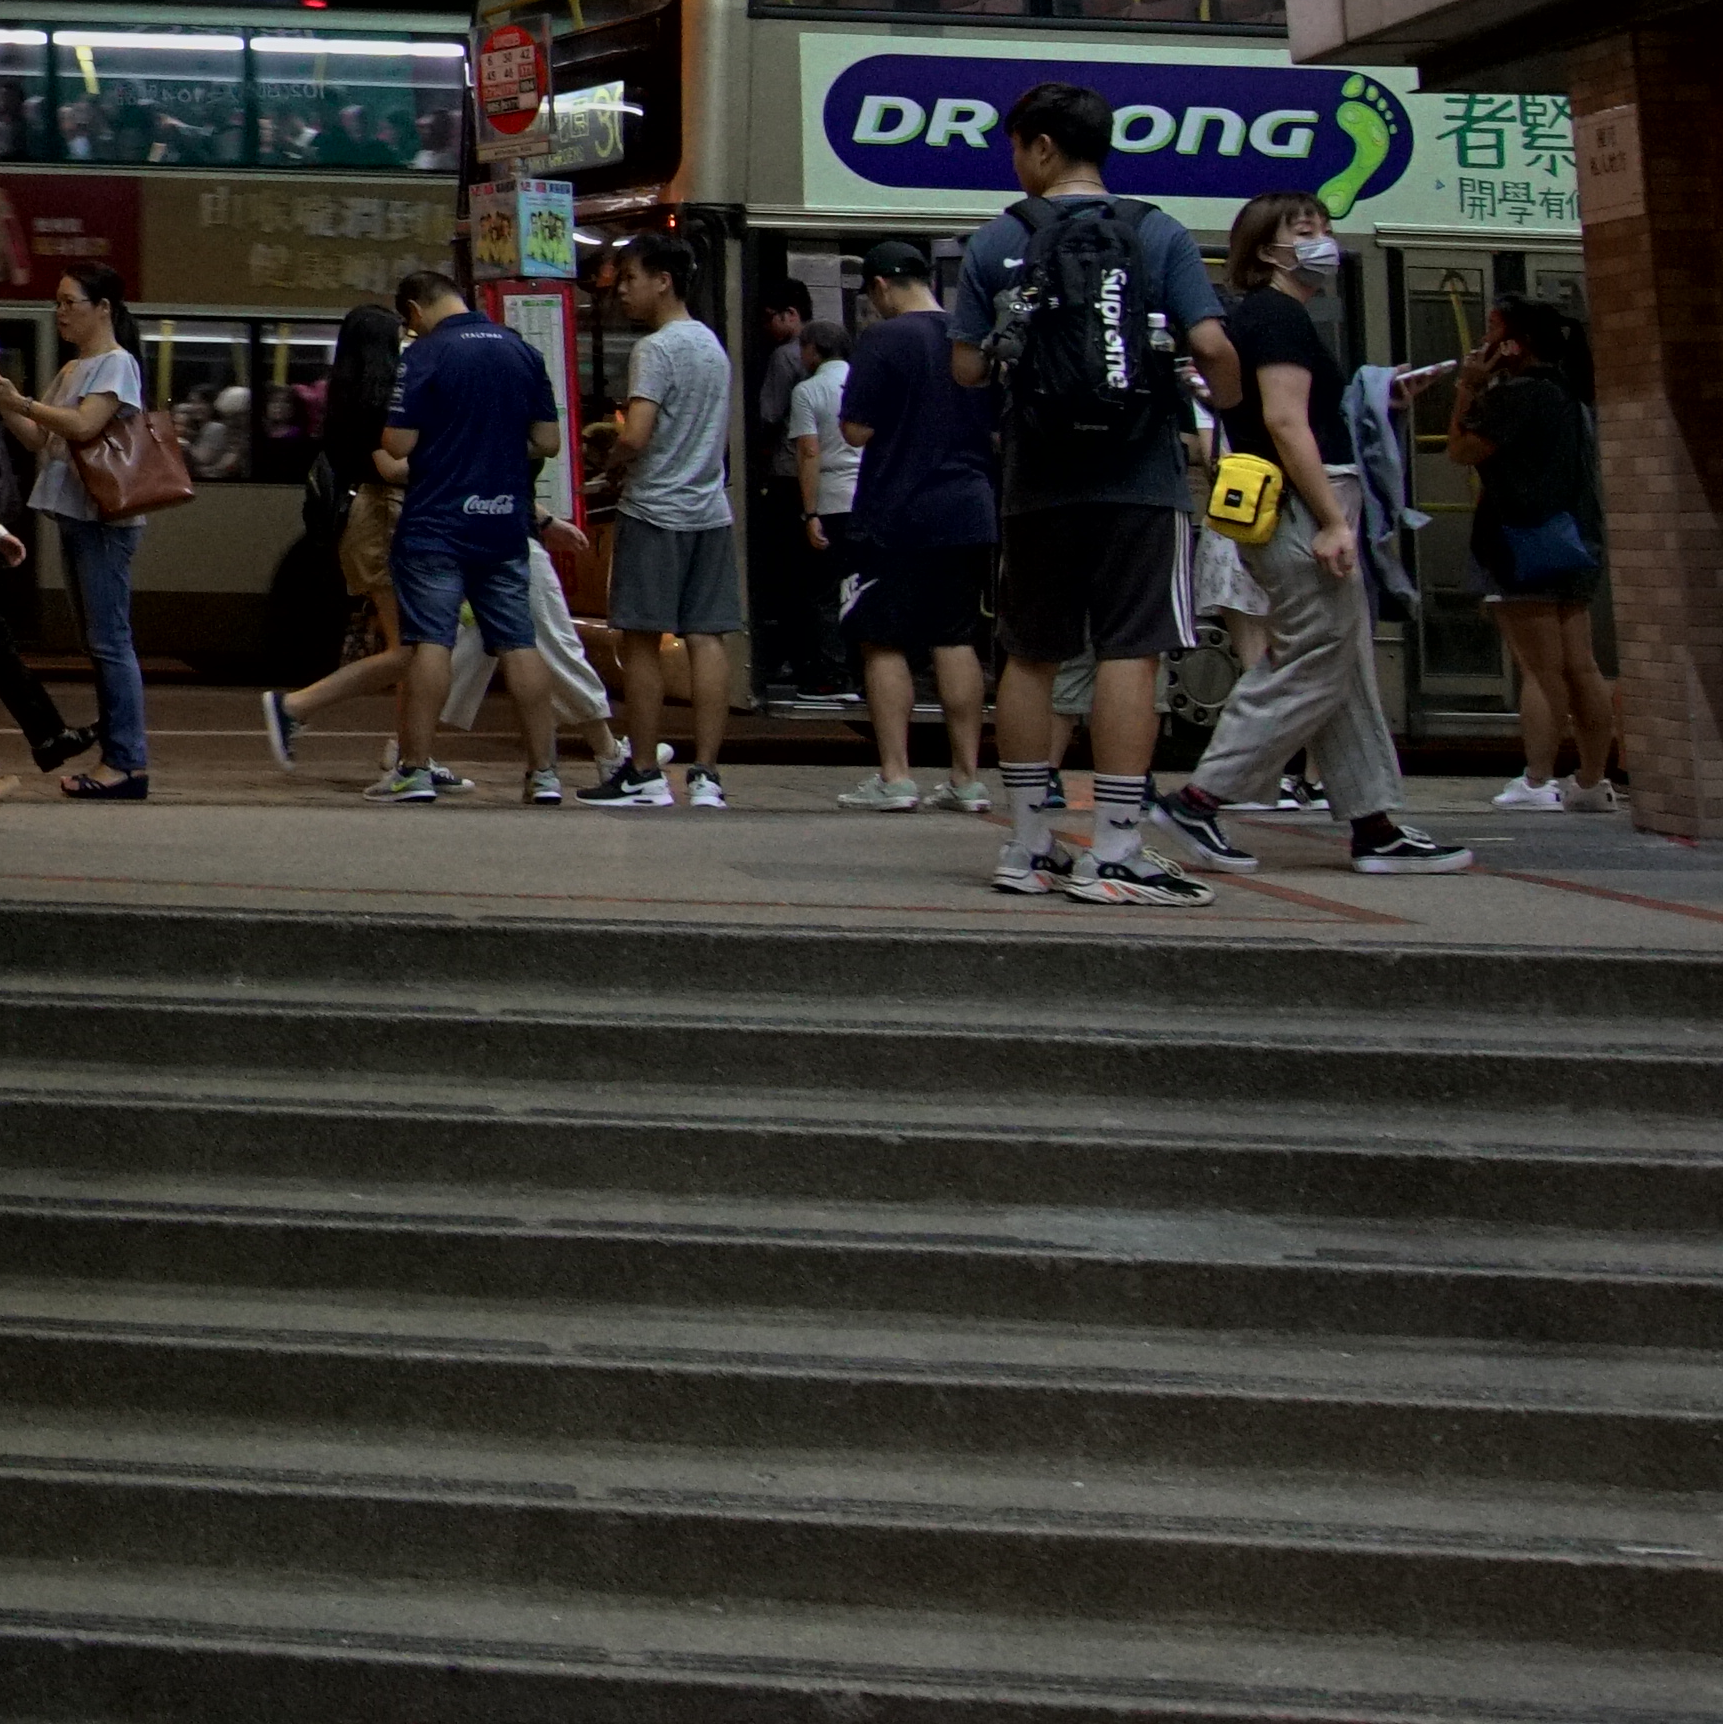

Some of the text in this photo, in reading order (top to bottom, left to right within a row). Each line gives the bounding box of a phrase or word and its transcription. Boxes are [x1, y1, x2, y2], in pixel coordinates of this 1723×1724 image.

[851, 95, 1320, 160] DR ONG
[1094, 268, 1129, 389] Supreme
